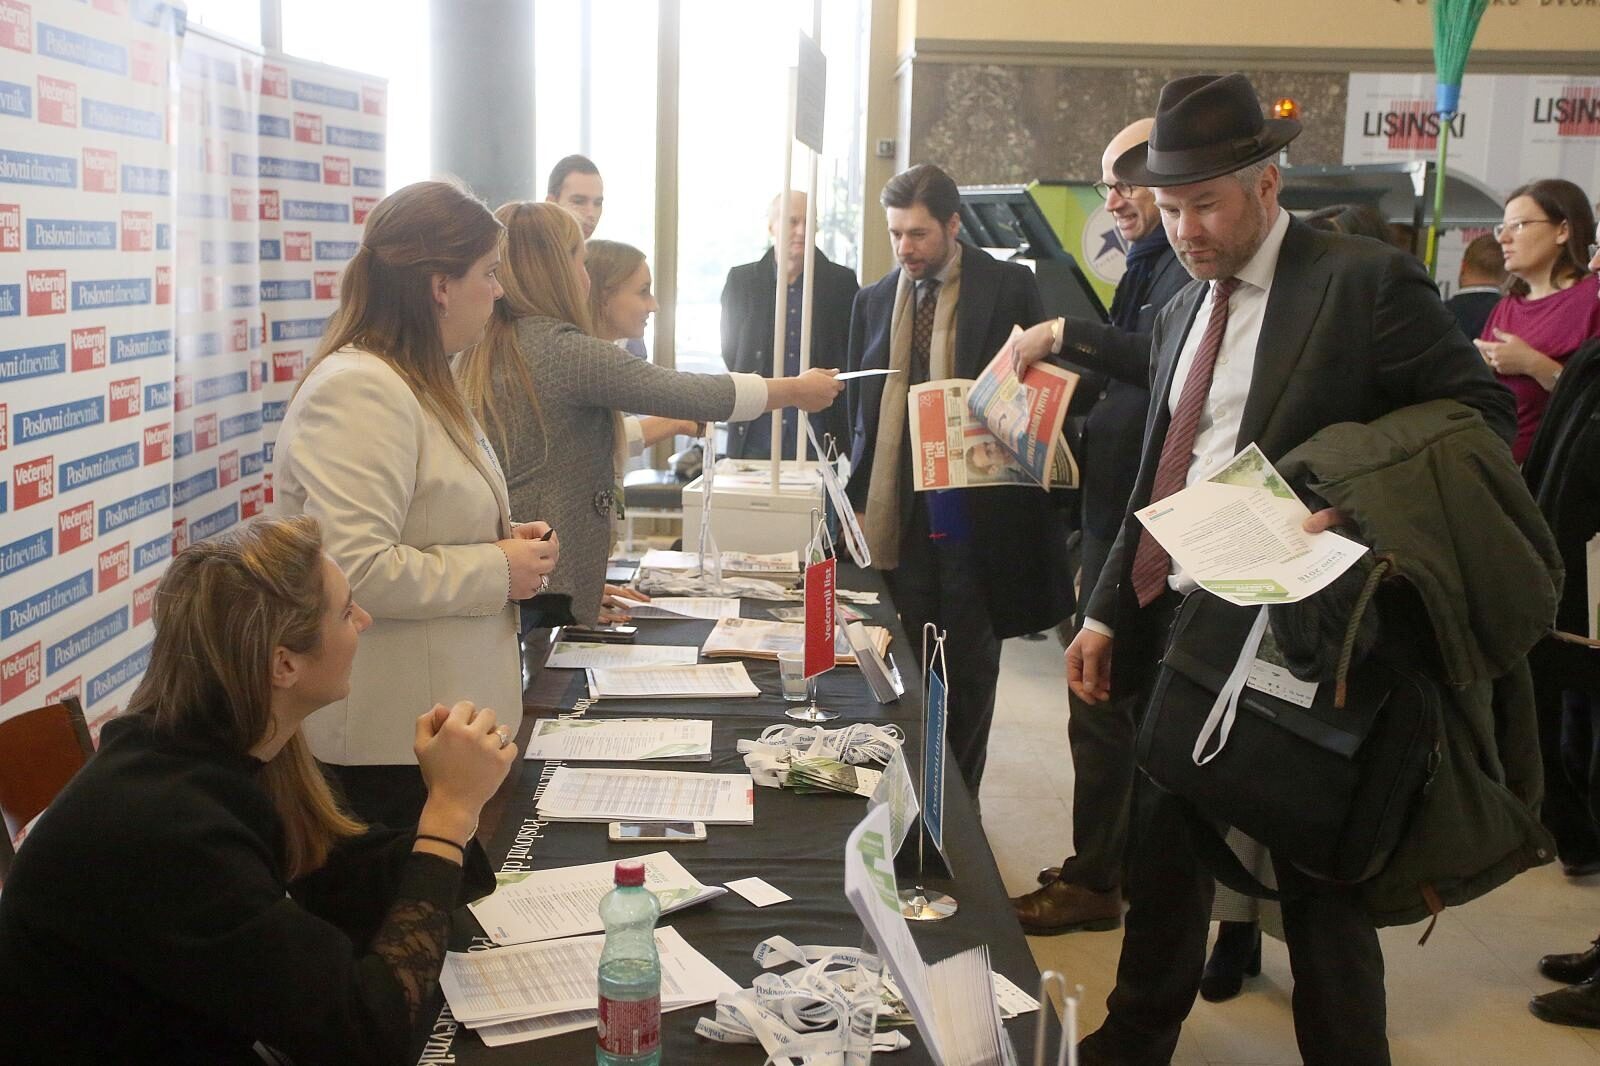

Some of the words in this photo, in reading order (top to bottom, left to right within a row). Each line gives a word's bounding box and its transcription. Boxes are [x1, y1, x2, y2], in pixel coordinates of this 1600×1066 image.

[36, 224, 75, 246] Poslovni
[29, 273, 65, 293] Večernji
[80, 284, 115, 306] Poslovni
[52, 291, 65, 310] list
[73, 330, 104, 350] Večernji
[117, 337, 149, 360] Poslovni
[19, 350, 60, 376] dnevnik
[93, 347, 104, 366] list
[111, 380, 139, 400] Večernji
[128, 395, 139, 414] list
[23, 410, 63, 439] Poslovni
[65, 401, 98, 426] dnevnik
[934, 441, 946, 459] list
[15, 460, 52, 486] Večernji
[66, 458, 102, 487] Poslovni
[103, 450, 135, 475] dnevnik
[923, 441, 936, 487] Večernji
[38, 478, 53, 499] list
[61, 504, 92, 531] Večernji
[106, 498, 137, 530] Poslovni
[80, 521, 92, 543] list
[6, 537, 47, 571] dnevnik
[101, 547, 128, 571] Večernji
[116, 562, 128, 581] list
[824, 566, 833, 588] list
[10, 594, 50, 632] Poslovni
[51, 577, 87, 611] dnevnik
[55, 628, 91, 669] Poslovni
[91, 613, 122, 648] dnevnik
[2, 646, 40, 681] Večernji
[25, 661, 40, 687] list
[94, 660, 125, 700] Poslovni
[505, 818, 549, 860] Poslovni
